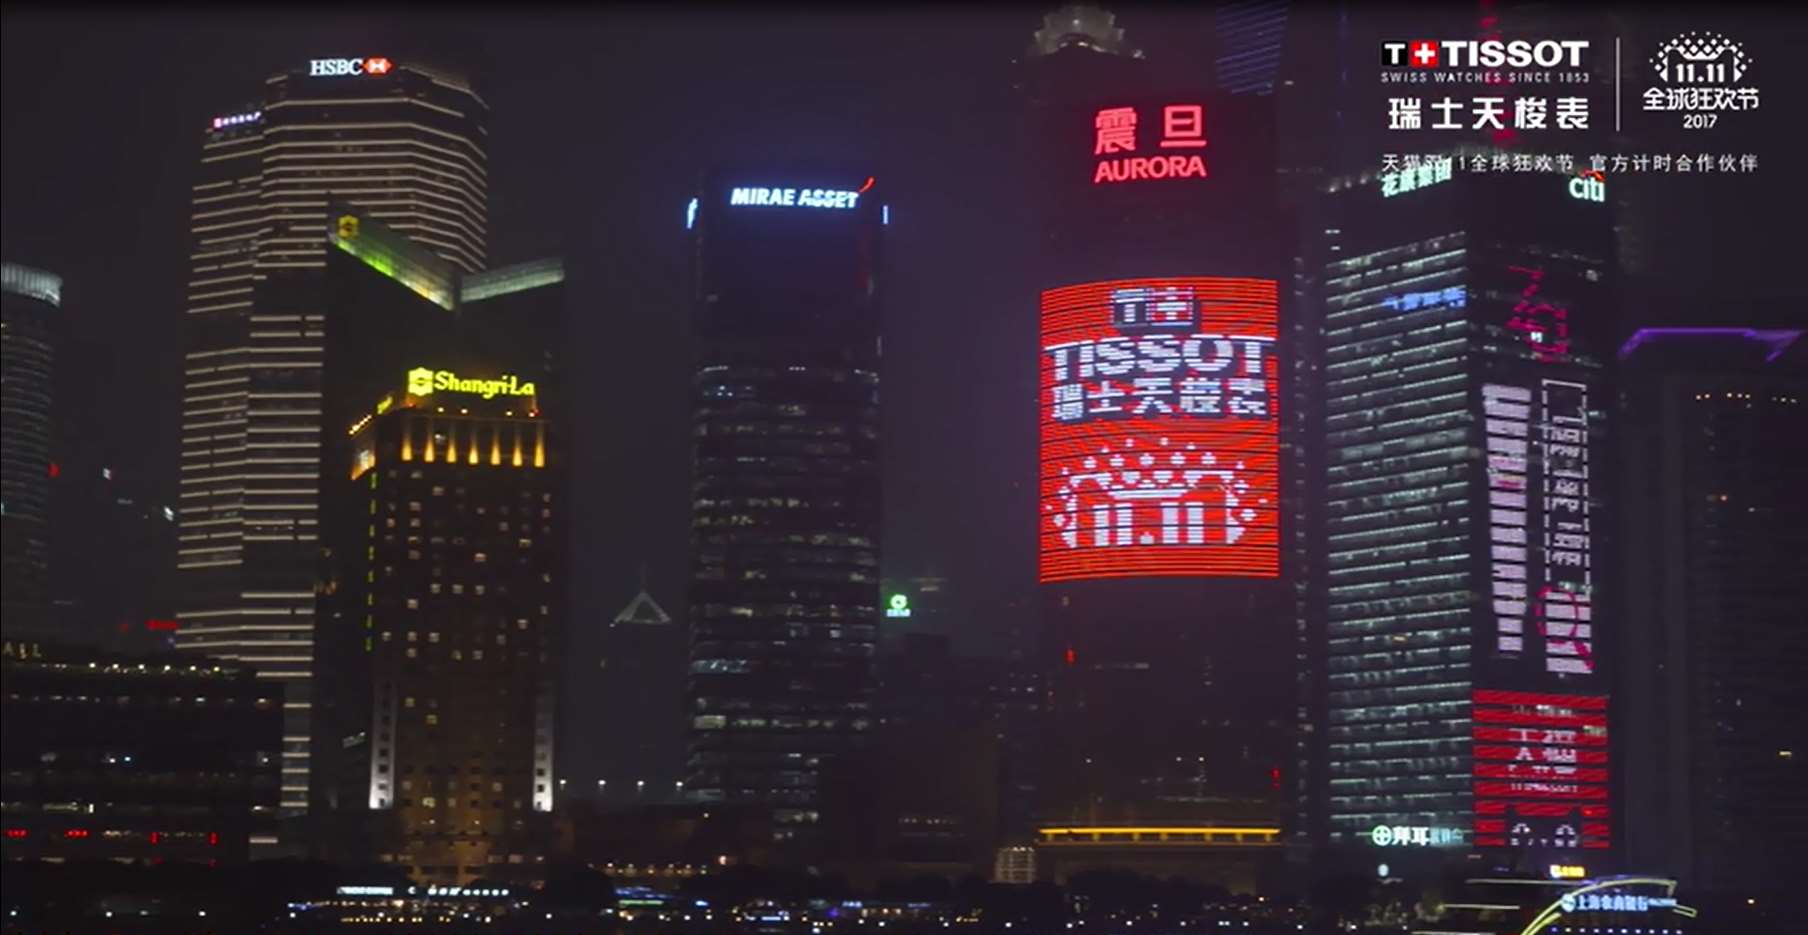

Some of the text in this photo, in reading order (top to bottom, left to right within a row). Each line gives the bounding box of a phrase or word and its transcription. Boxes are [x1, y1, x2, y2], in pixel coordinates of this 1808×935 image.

[309, 58, 364, 77] HSBC
[1094, 104, 1208, 156] 震旦
[1094, 155, 1208, 184] AURORA
[730, 187, 860, 209] MIRAE ASSET
[1043, 333, 1278, 381] TISSOT
[1092, 500, 1206, 547] 11.11
